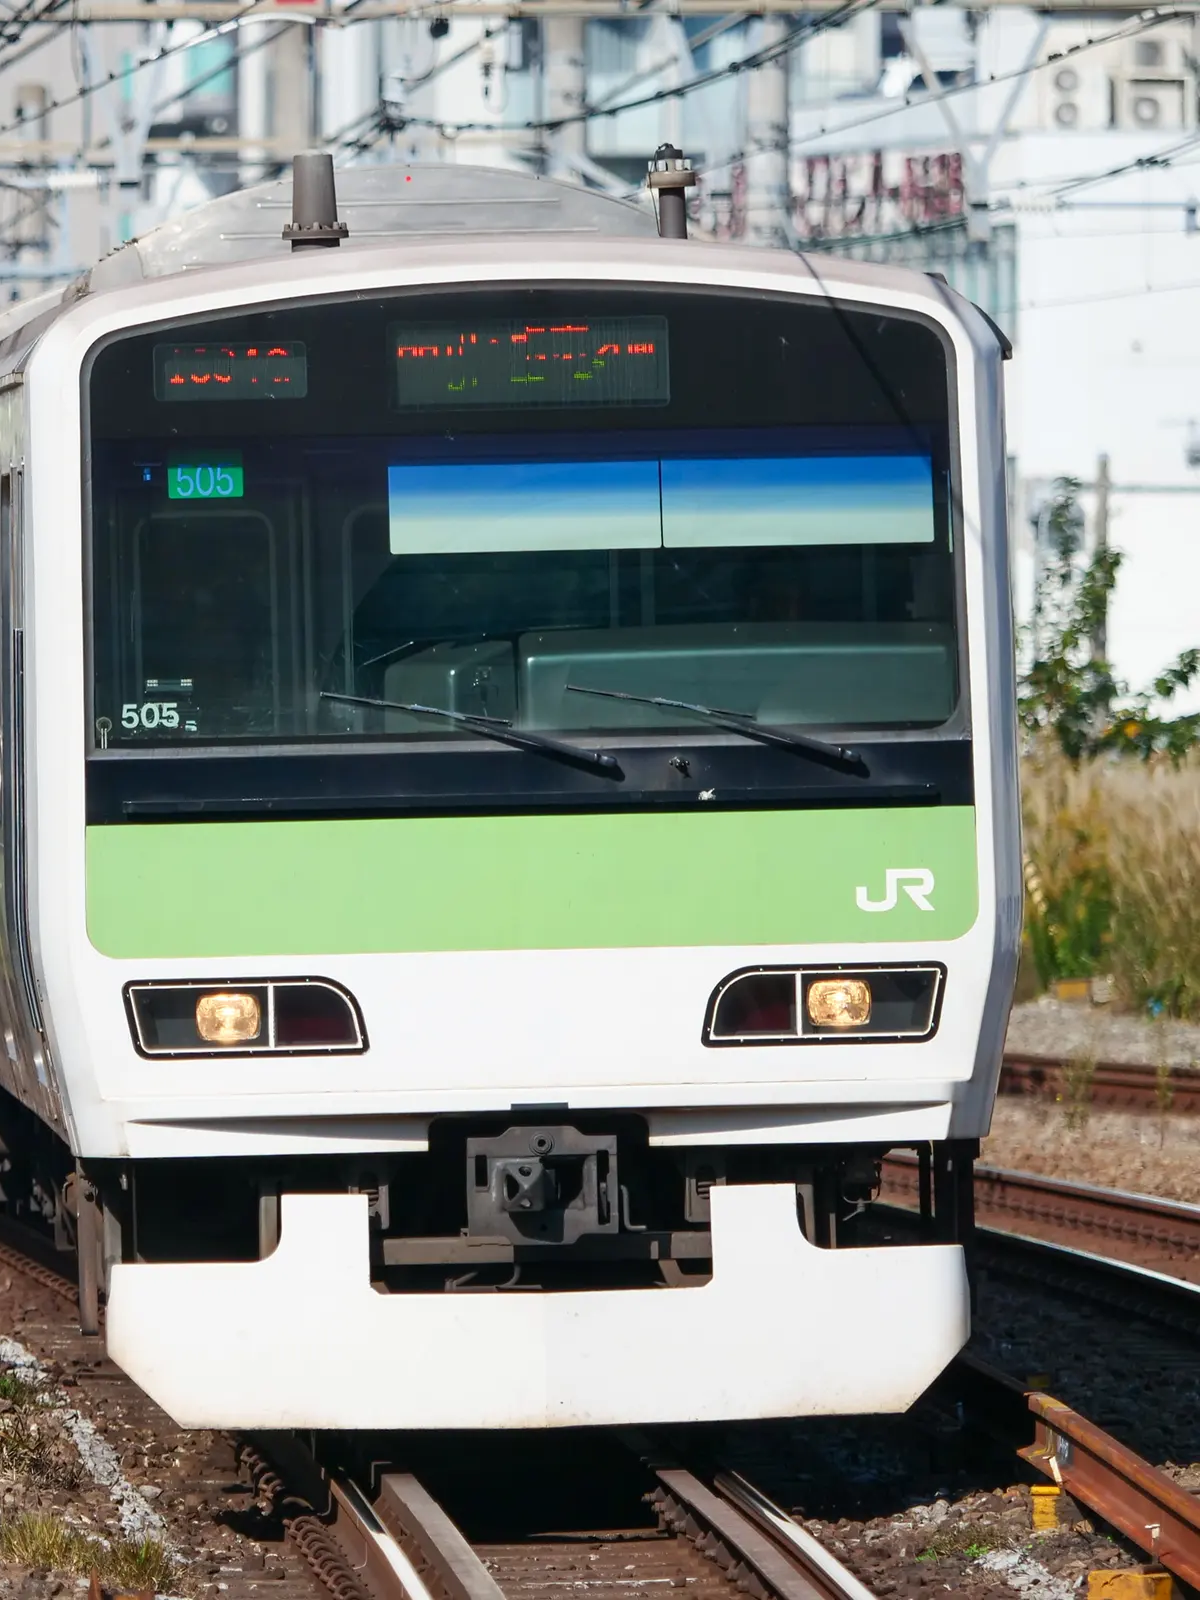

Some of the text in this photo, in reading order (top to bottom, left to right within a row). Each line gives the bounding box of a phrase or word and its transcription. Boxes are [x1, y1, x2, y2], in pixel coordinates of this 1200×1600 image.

[177, 463, 233, 496] 505
[121, 702, 179, 728] 505
[855, 868, 935, 912] JR
